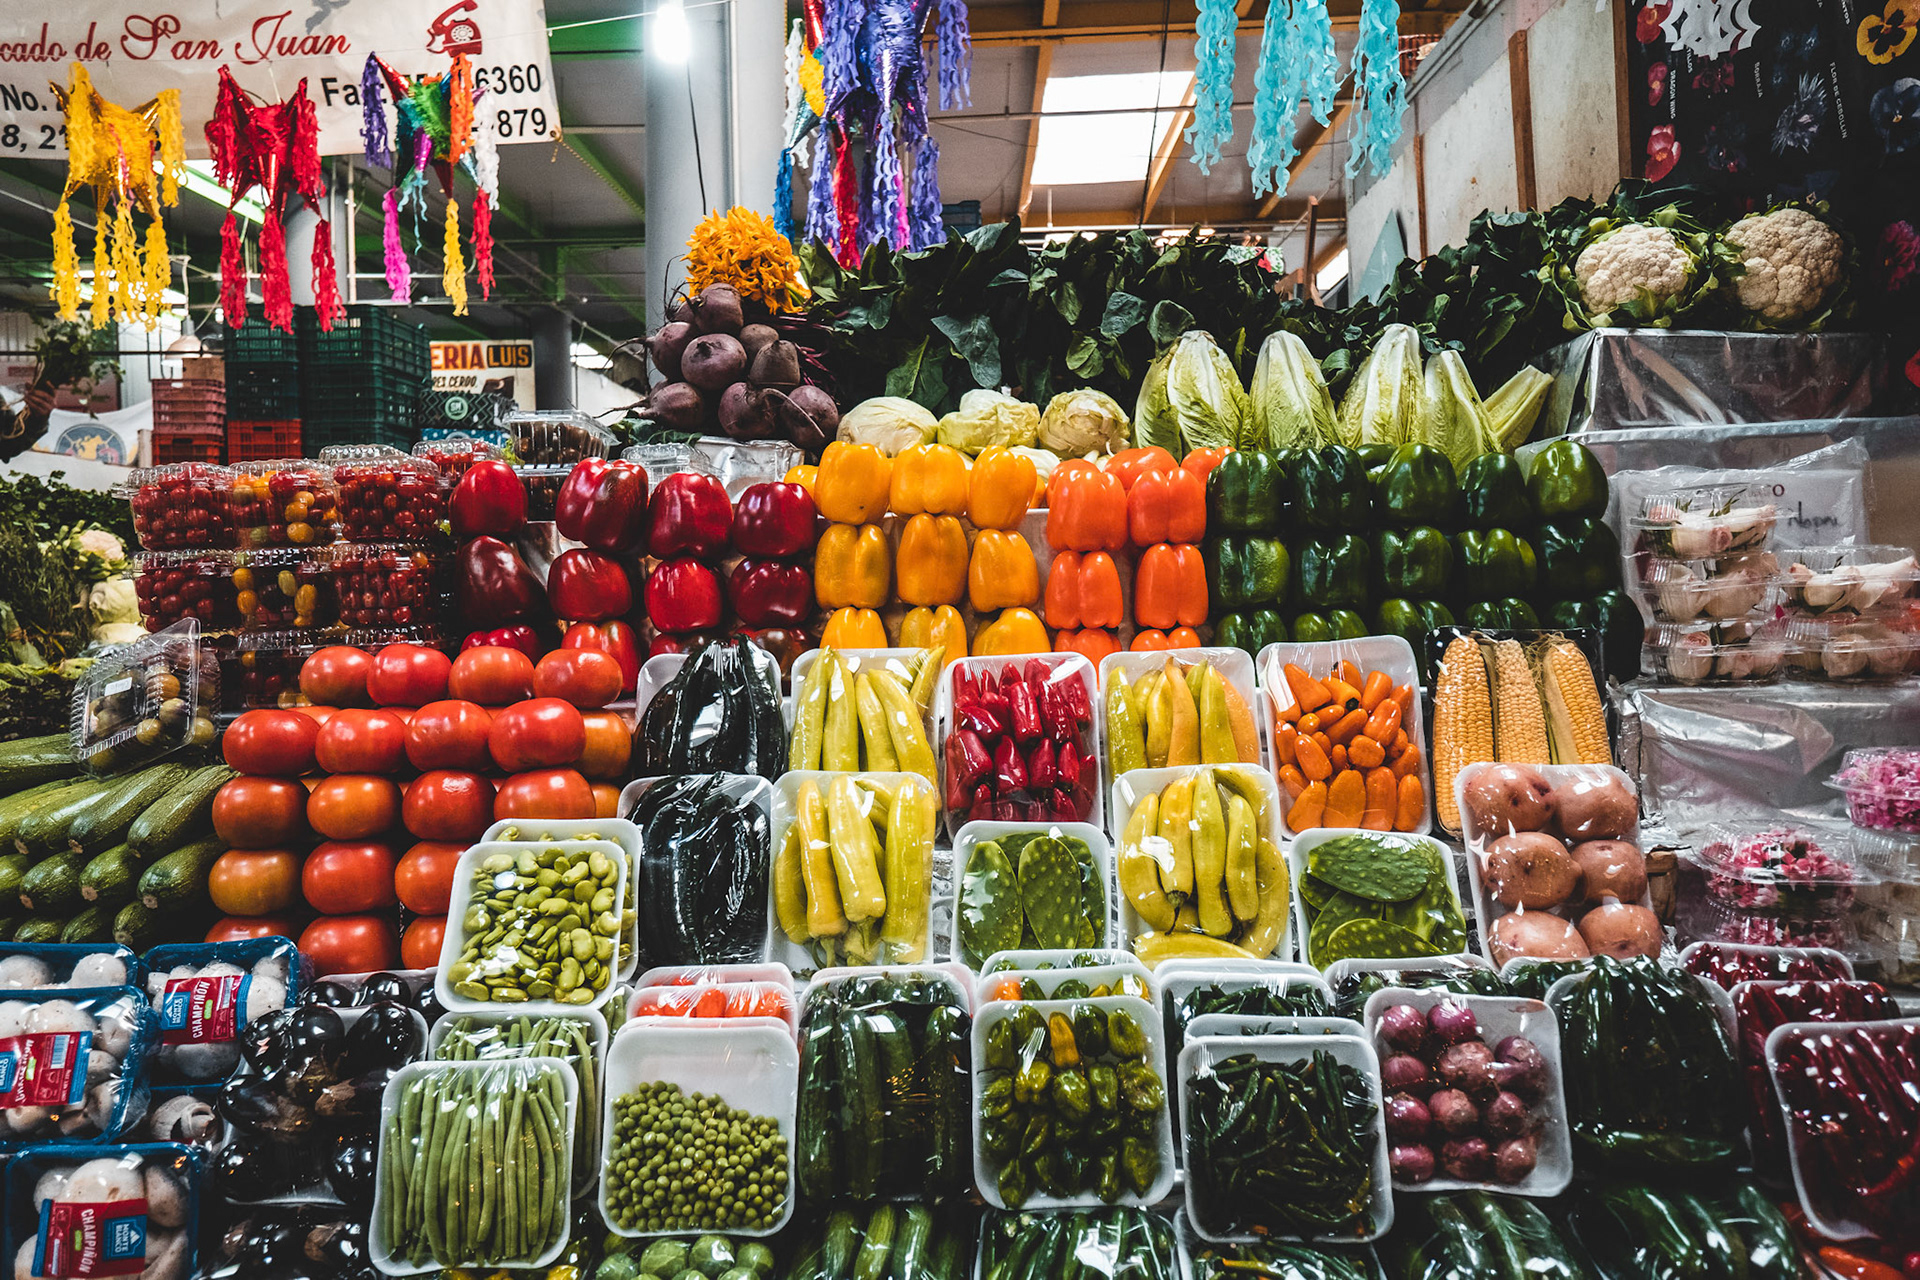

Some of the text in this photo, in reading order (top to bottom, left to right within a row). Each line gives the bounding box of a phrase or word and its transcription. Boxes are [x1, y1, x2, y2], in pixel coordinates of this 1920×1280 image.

[74, 21, 112, 62] de
[120, 14, 223, 61] San
[235, 10, 351, 65] Juan
[321, 76, 387, 106] Fa:
[1754, 61, 1763, 98] BORRAJA
[0, 83, 47, 111] No.
[1829, 62, 1848, 139] FLOR DE CEBOLLIN
[488, 346, 529, 367] LUIS
[114, 1225, 123, 1253] BLANCO
[121, 1224, 130, 1252] MONTE
